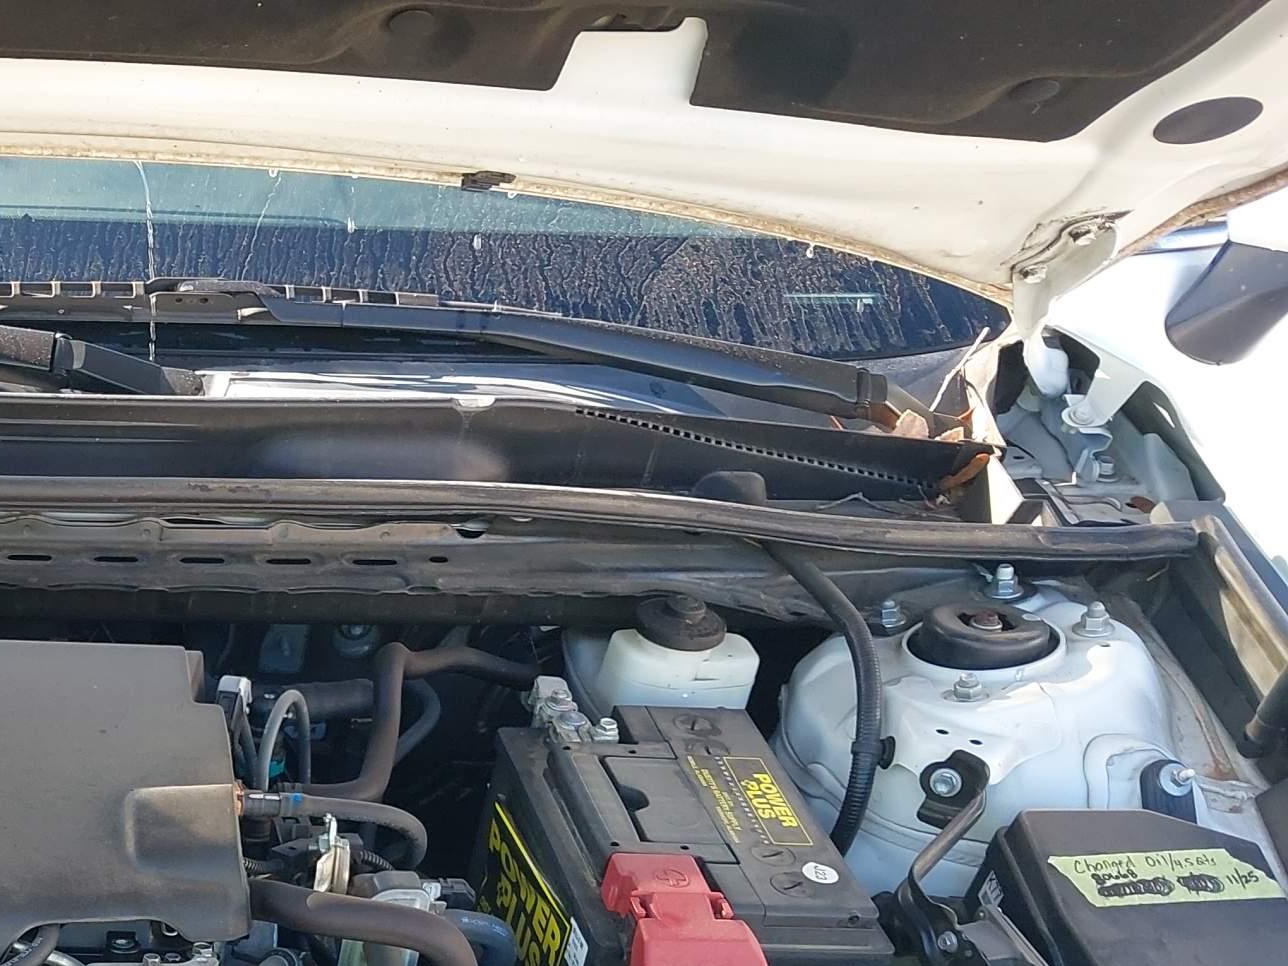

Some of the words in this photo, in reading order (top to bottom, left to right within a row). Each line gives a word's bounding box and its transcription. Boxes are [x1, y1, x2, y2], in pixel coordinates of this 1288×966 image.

[740, 779, 777, 819] PLUS
[752, 773, 798, 827] POWER
[1074, 855, 1136, 874] Changed
[1226, 867, 1259, 889] 11/25
